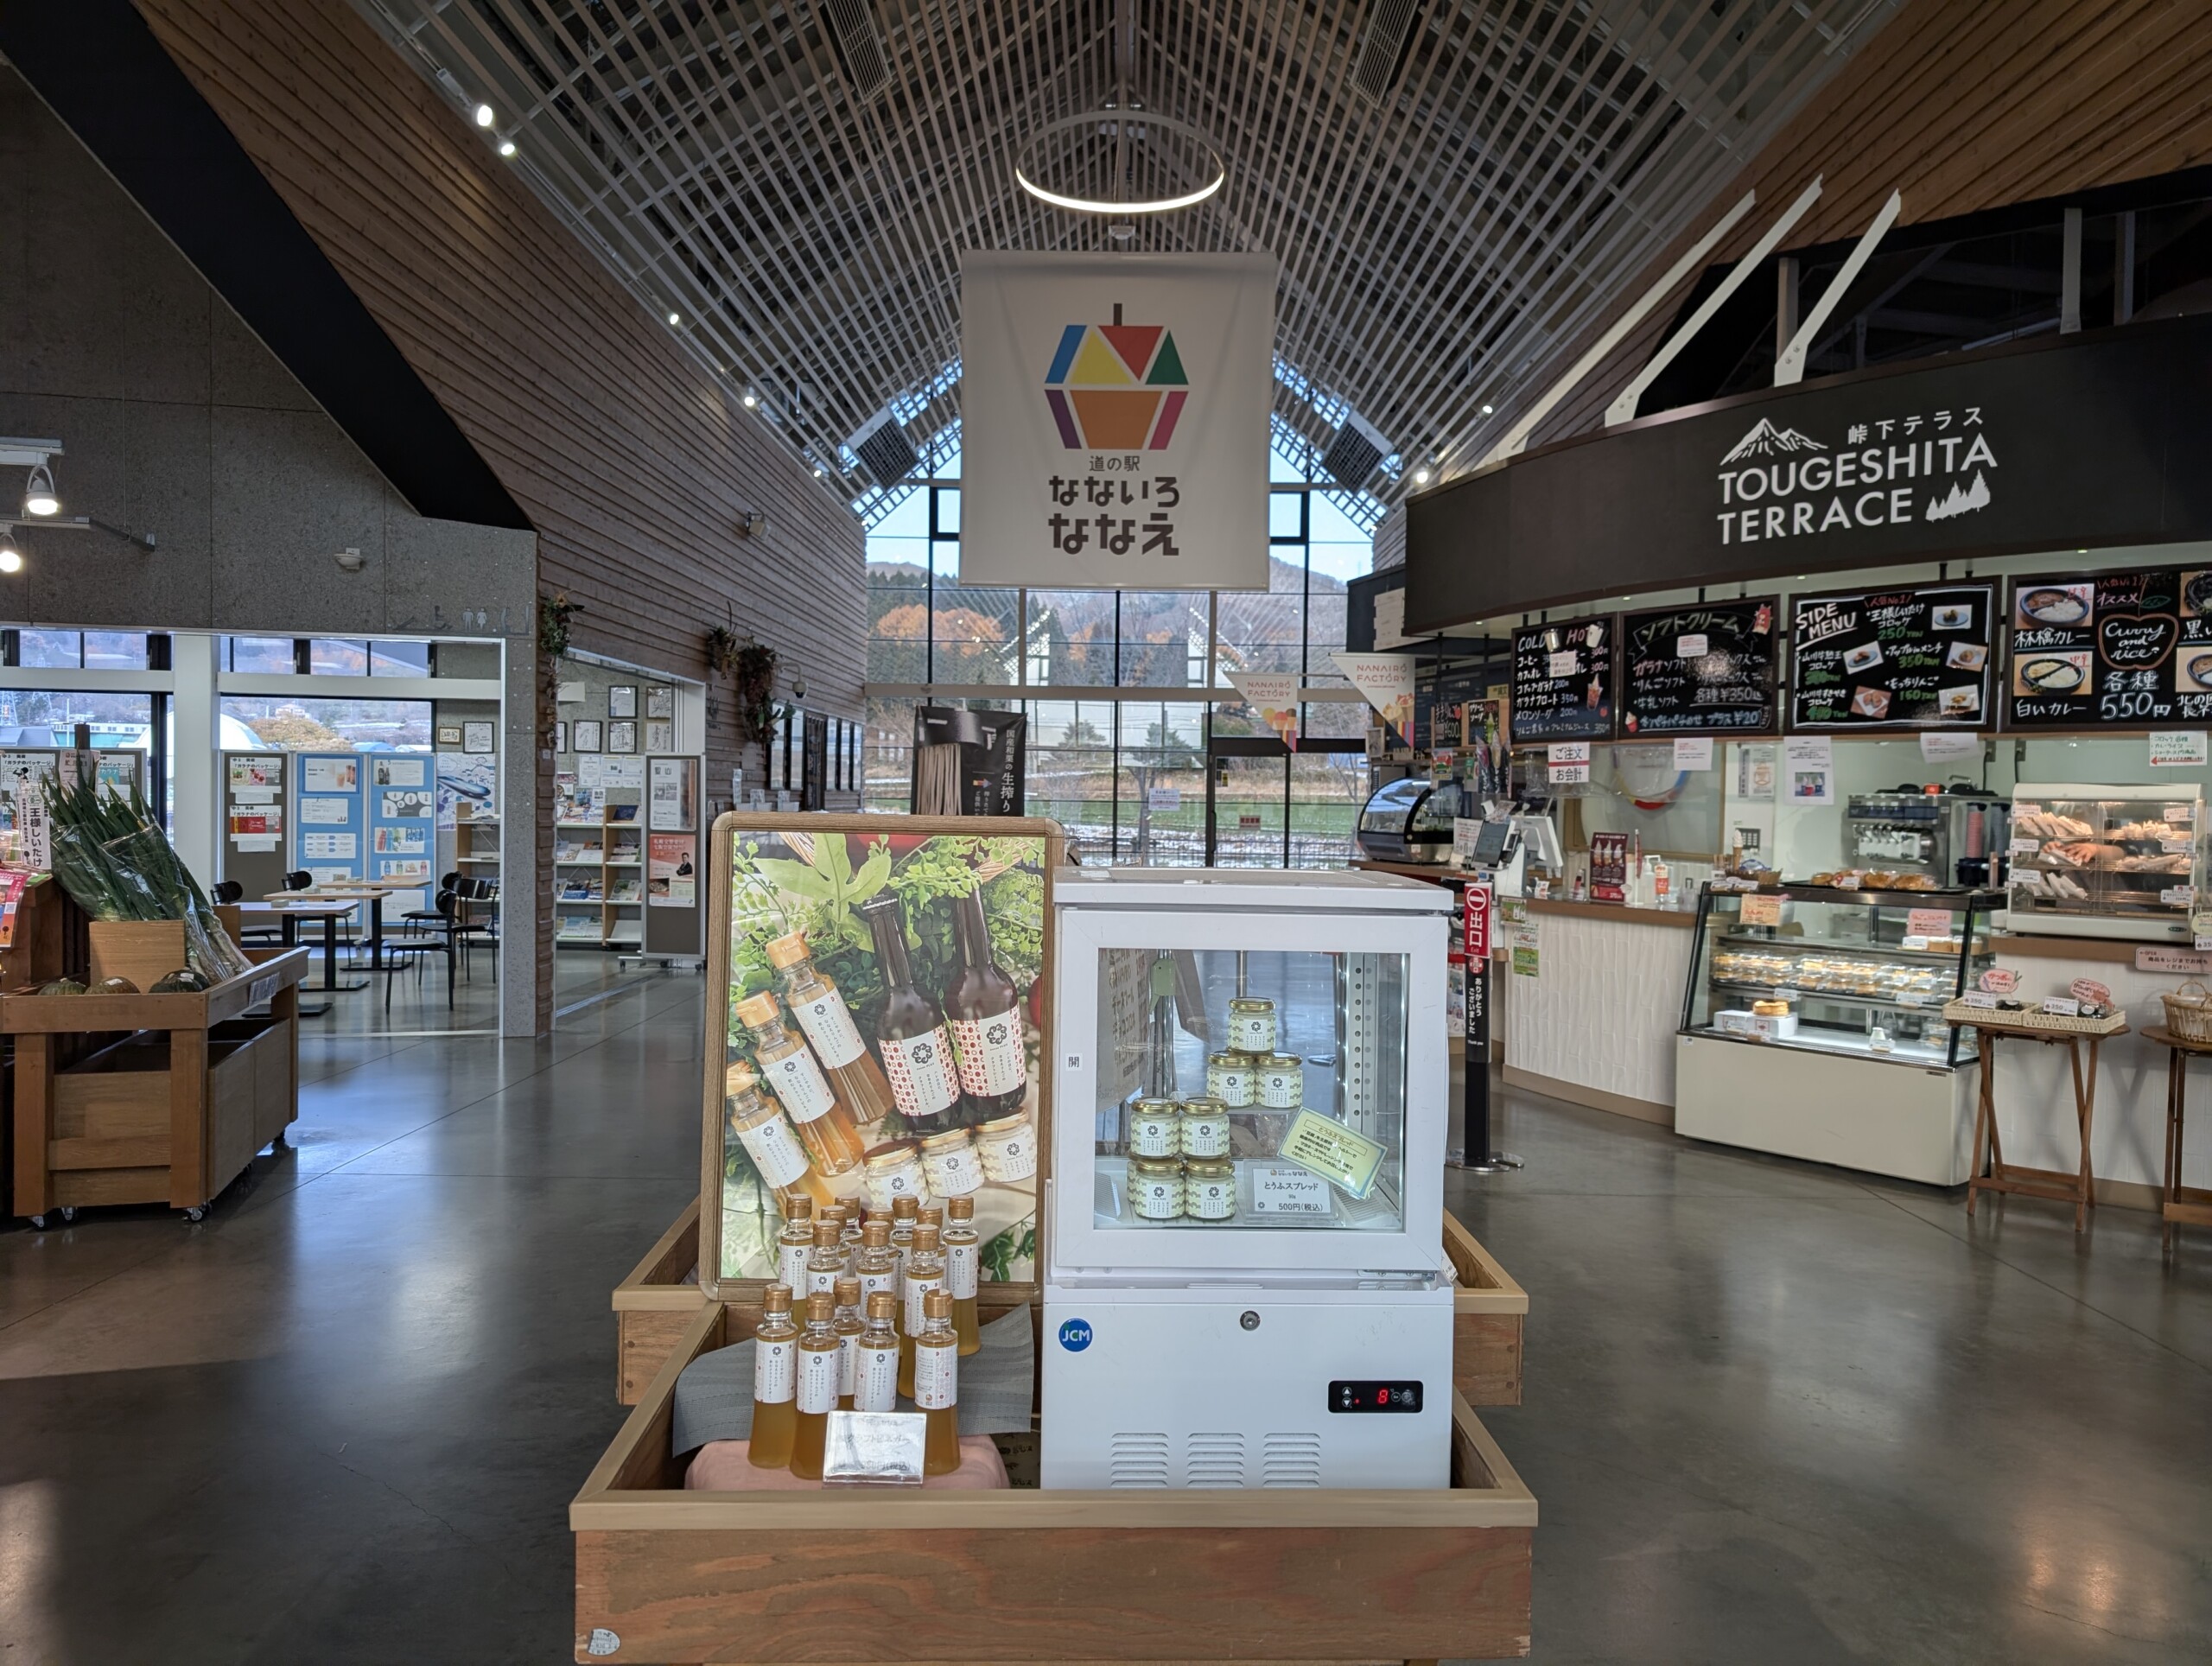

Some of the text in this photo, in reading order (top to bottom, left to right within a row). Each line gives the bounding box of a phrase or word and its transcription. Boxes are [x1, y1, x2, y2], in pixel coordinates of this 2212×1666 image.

[1848, 407, 1983, 444] 峠下テラス
[1089, 455, 1140, 472] 道の駅
[1719, 433, 1998, 504] TOUGESHITA
[1048, 475, 1180, 508] なないろ
[1717, 487, 1913, 545] TERRACE
[1047, 512, 1180, 556] ななえ
[1641, 613, 1740, 641] ソフトクリーム
[1796, 603, 1839, 630] SIDE
[1808, 611, 1857, 639] MENU
[1878, 626, 1905, 640] 250
[2014, 627, 2091, 648] 林檎カレー
[2105, 622, 2167, 641] Curry
[2111, 646, 2153, 660] rice
[2119, 638, 2149, 648] and
[2102, 671, 2160, 692] 各種
[2017, 699, 2087, 717] 白いカレー
[2100, 692, 2171, 720] 550円
[1555, 747, 1583, 760] ご注文
[1555, 767, 1582, 781] お会計
[29, 807, 42, 868] 王様しいたけ
[1469, 912, 1483, 947] 出口
[1068, 1056, 1079, 1067] 開
[1264, 1181, 1319, 1191] とうふスプレッド
[1279, 1202, 1324, 1211] 500円(税込)
[1378, 1389, 1389, 1404] 8
